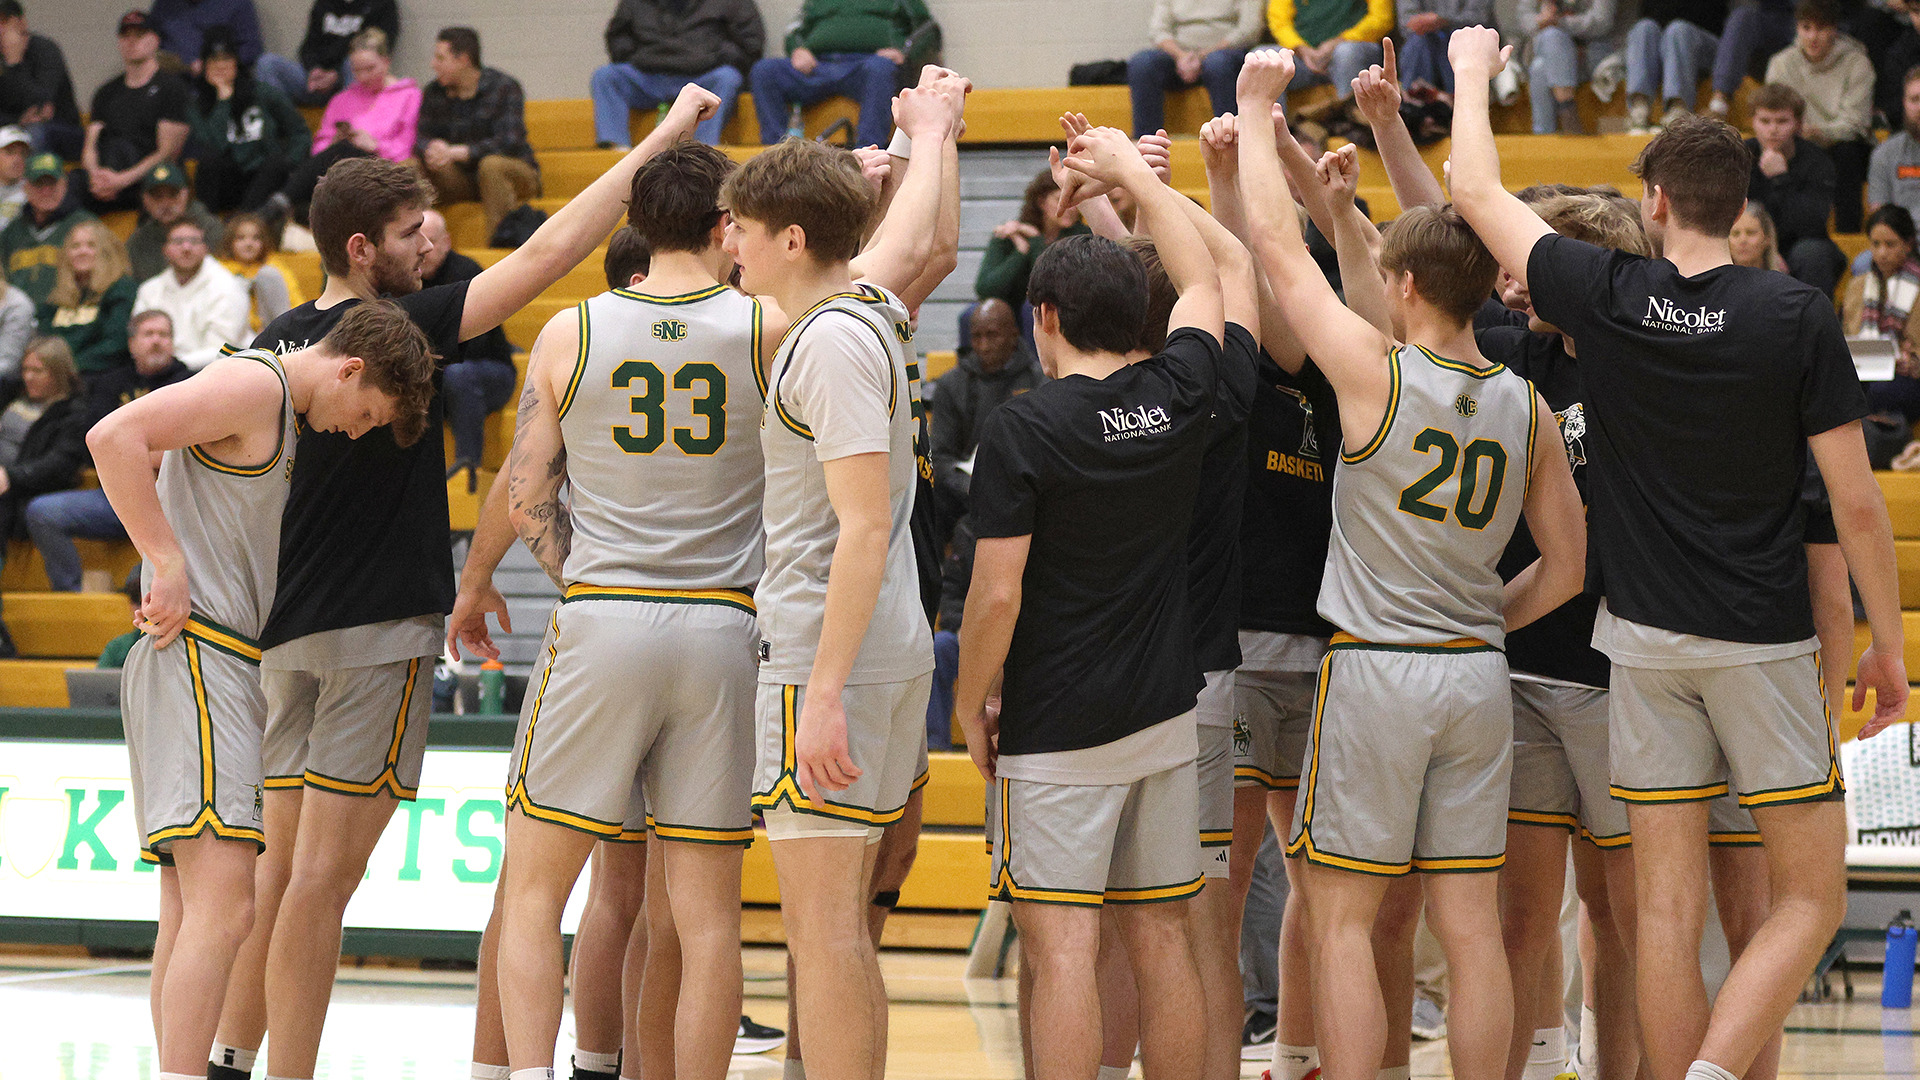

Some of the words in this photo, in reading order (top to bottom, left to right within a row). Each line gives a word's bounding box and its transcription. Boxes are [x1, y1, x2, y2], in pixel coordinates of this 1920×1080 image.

[1643, 295, 1727, 328] Nicolet
[652, 319, 687, 342] SNC
[1641, 319, 1703, 335] NATIONAL
[1696, 325, 1725, 335] BANK
[611, 360, 728, 457] 33
[1096, 404, 1171, 434] Nicolet
[1455, 393, 1478, 418] SNC
[1104, 429, 1148, 443] NATIONAL
[1147, 423, 1172, 434] BANK
[1397, 427, 1508, 532] 20
